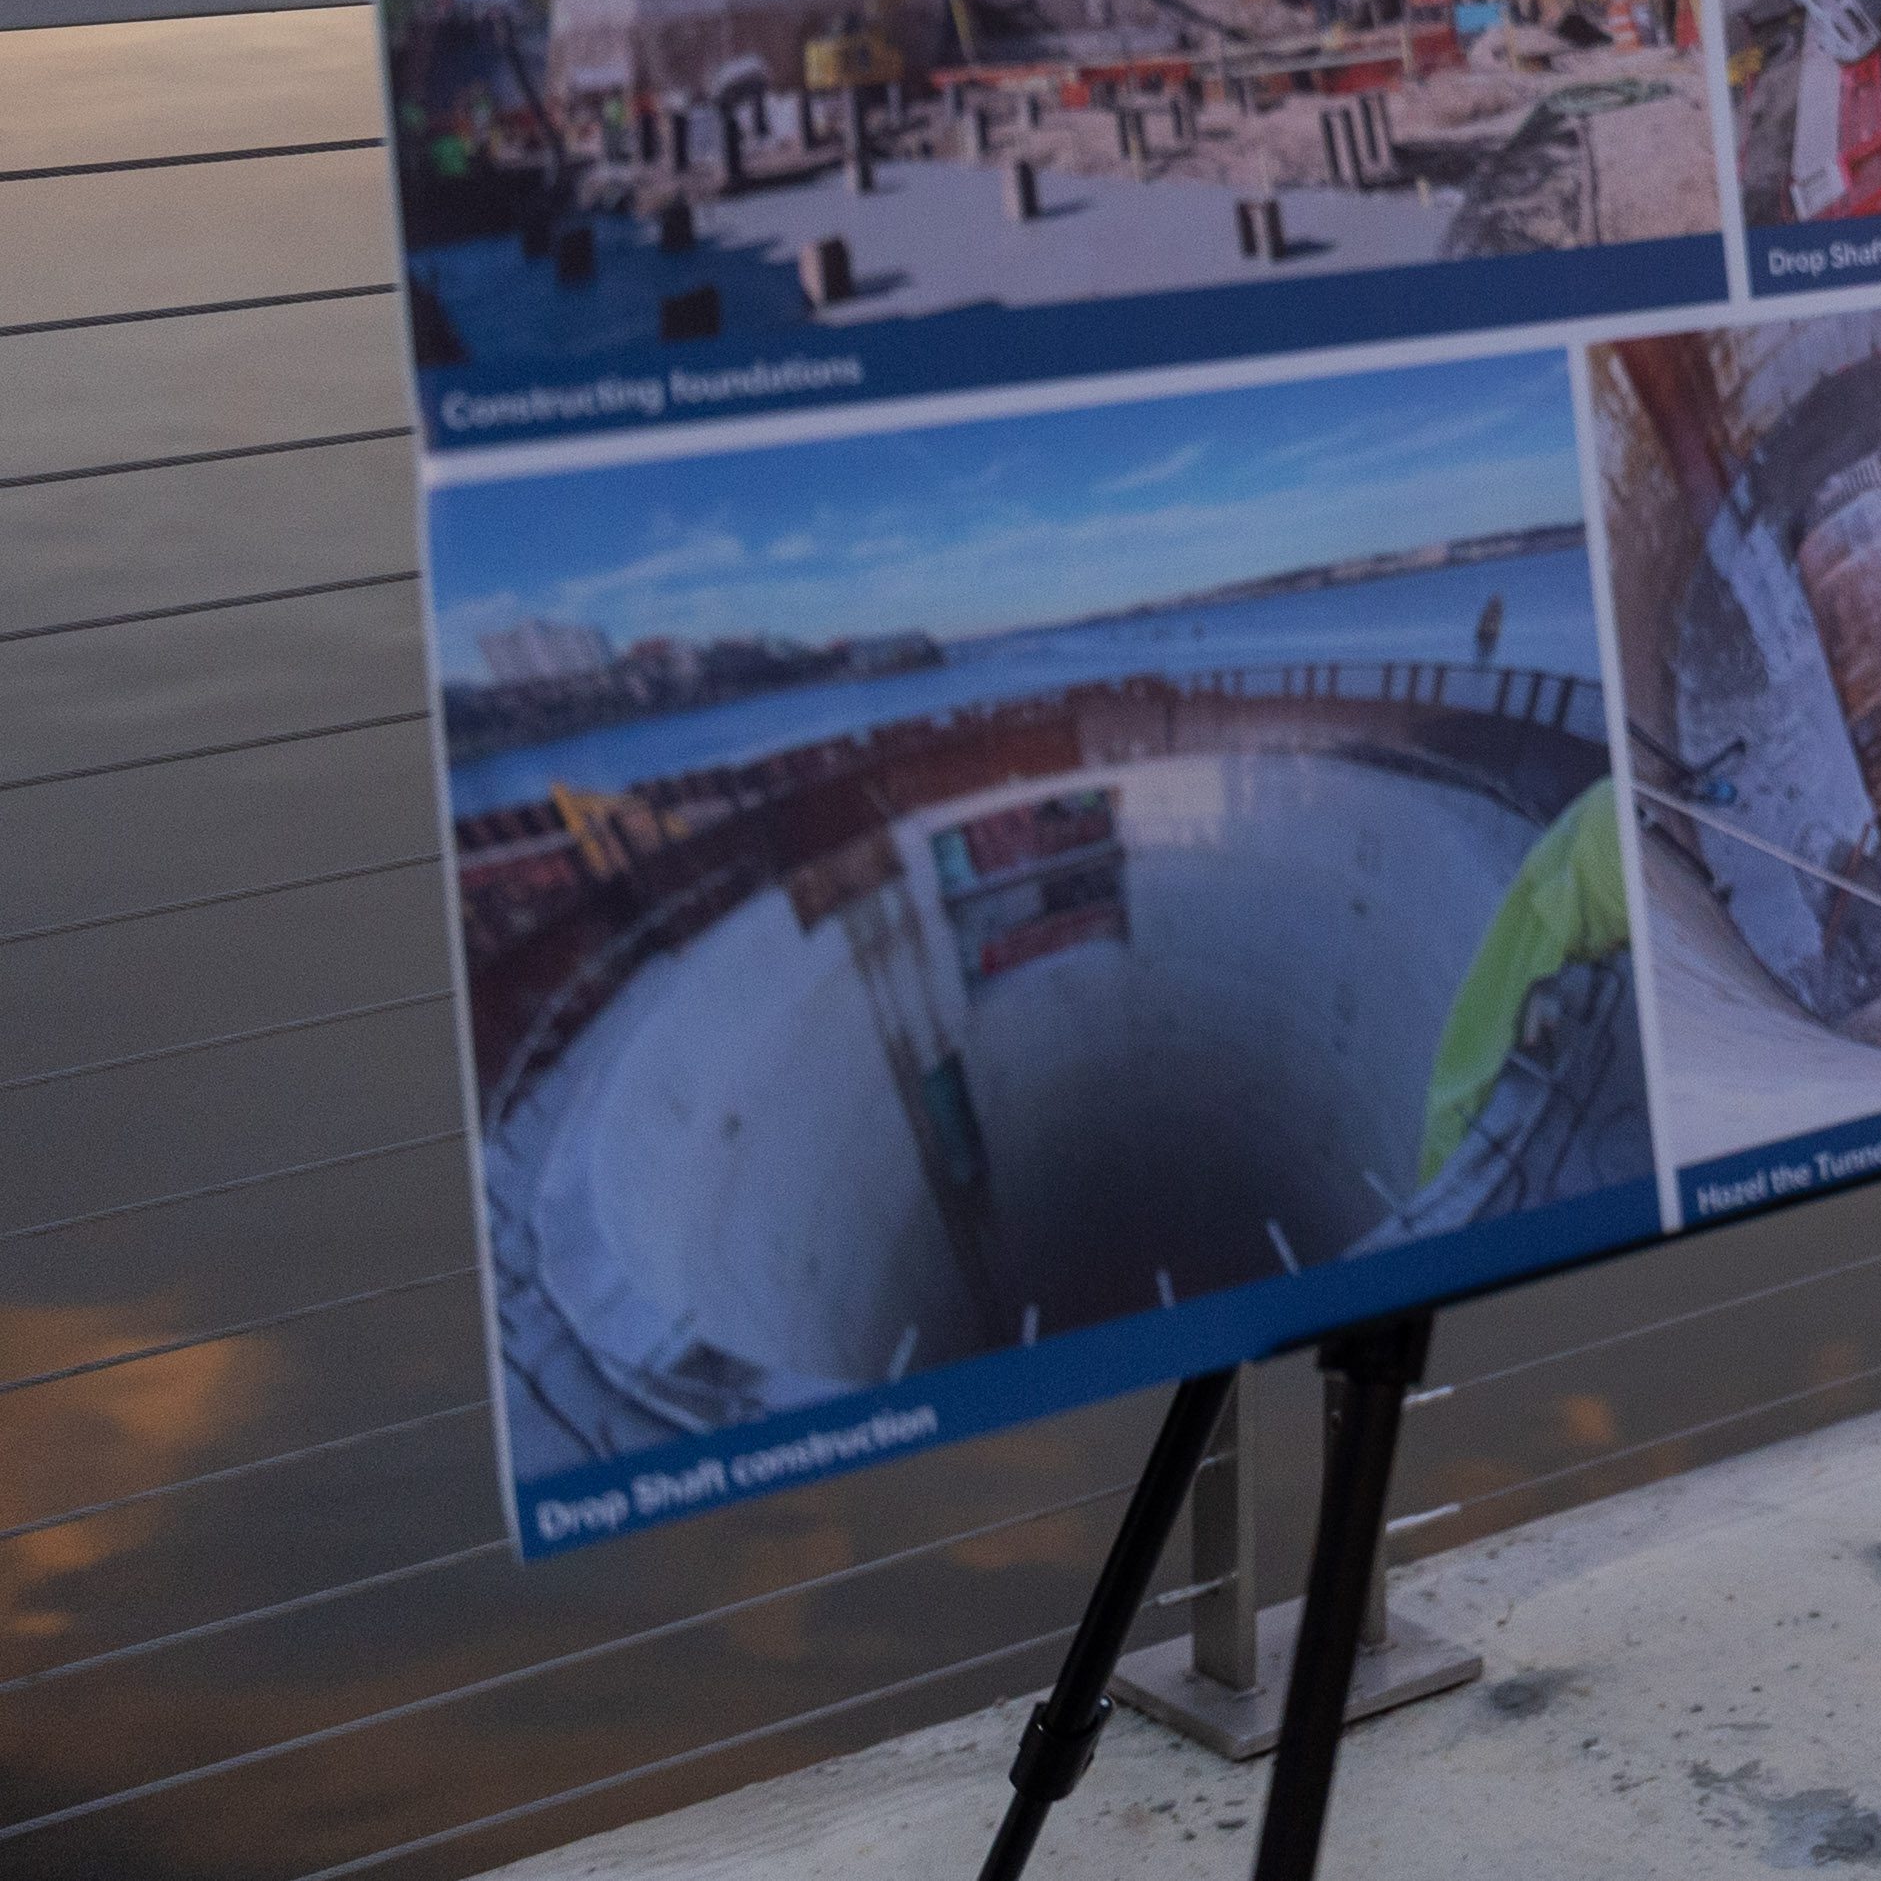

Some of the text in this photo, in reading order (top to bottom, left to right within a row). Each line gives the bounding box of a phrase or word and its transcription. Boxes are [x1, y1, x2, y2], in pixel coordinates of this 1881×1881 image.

[1768, 248, 1826, 276] Drop
[1698, 1168, 1767, 1212] Hazel
[1772, 1161, 1811, 1192] the
[535, 1407, 938, 1539] Drop Shaft construction
